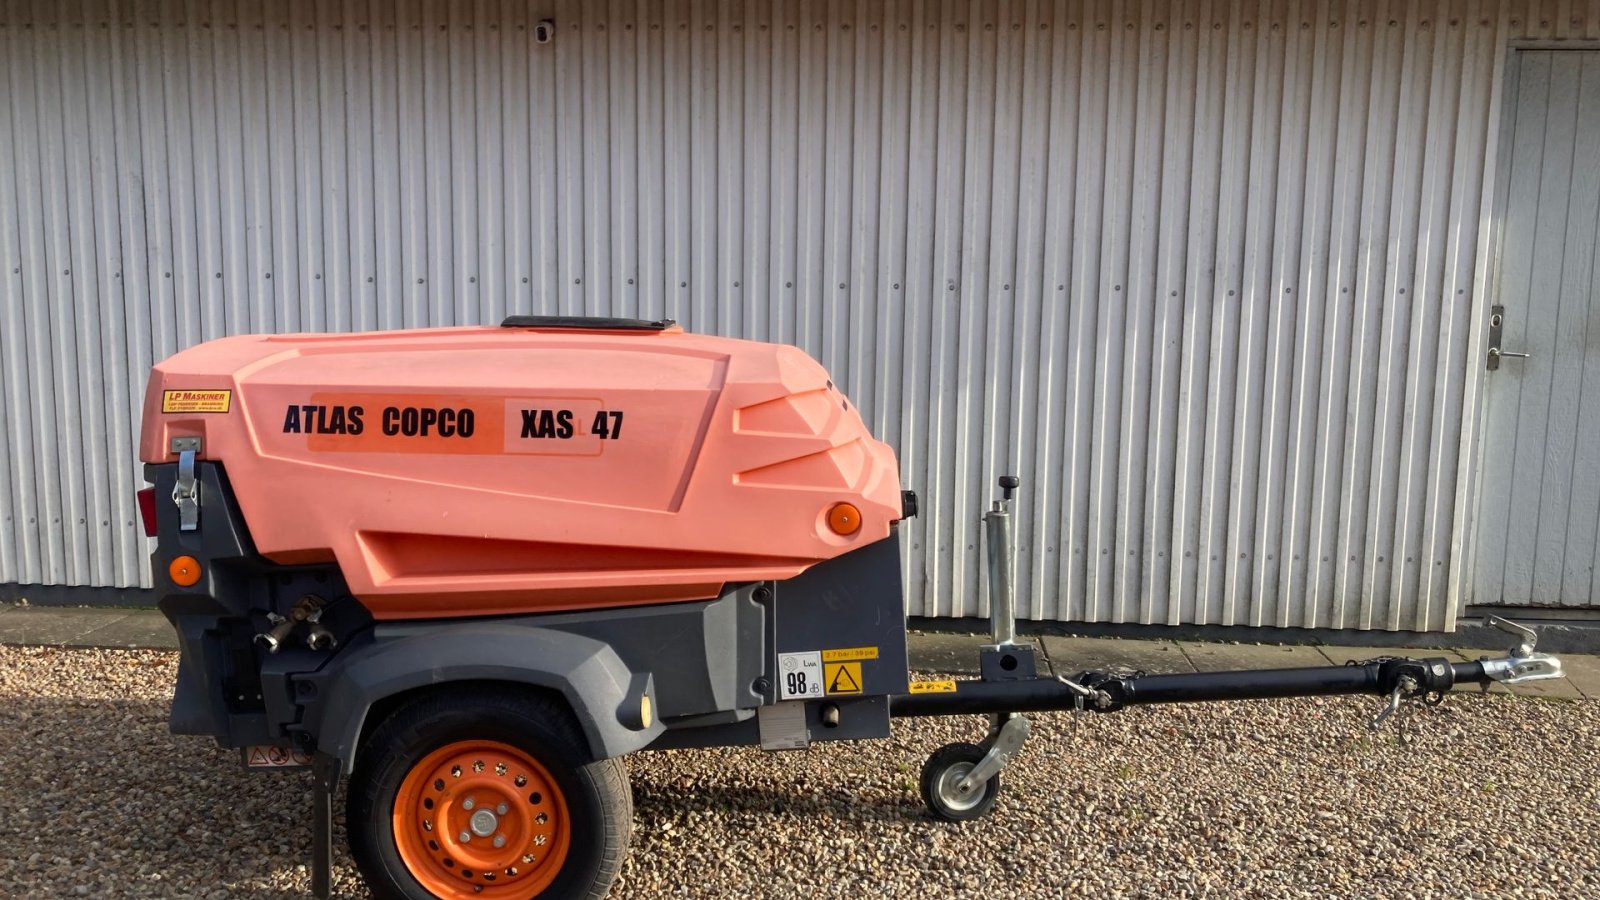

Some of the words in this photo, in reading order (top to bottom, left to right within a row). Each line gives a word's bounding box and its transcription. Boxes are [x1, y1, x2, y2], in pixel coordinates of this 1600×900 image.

[169, 393, 181, 401] LP
[283, 405, 364, 435] ATLAS
[382, 407, 475, 437] COPCO
[520, 409, 574, 439] XAS
[591, 410, 624, 440] 47
[787, 672, 807, 695] 98
[809, 683, 819, 693] dB
